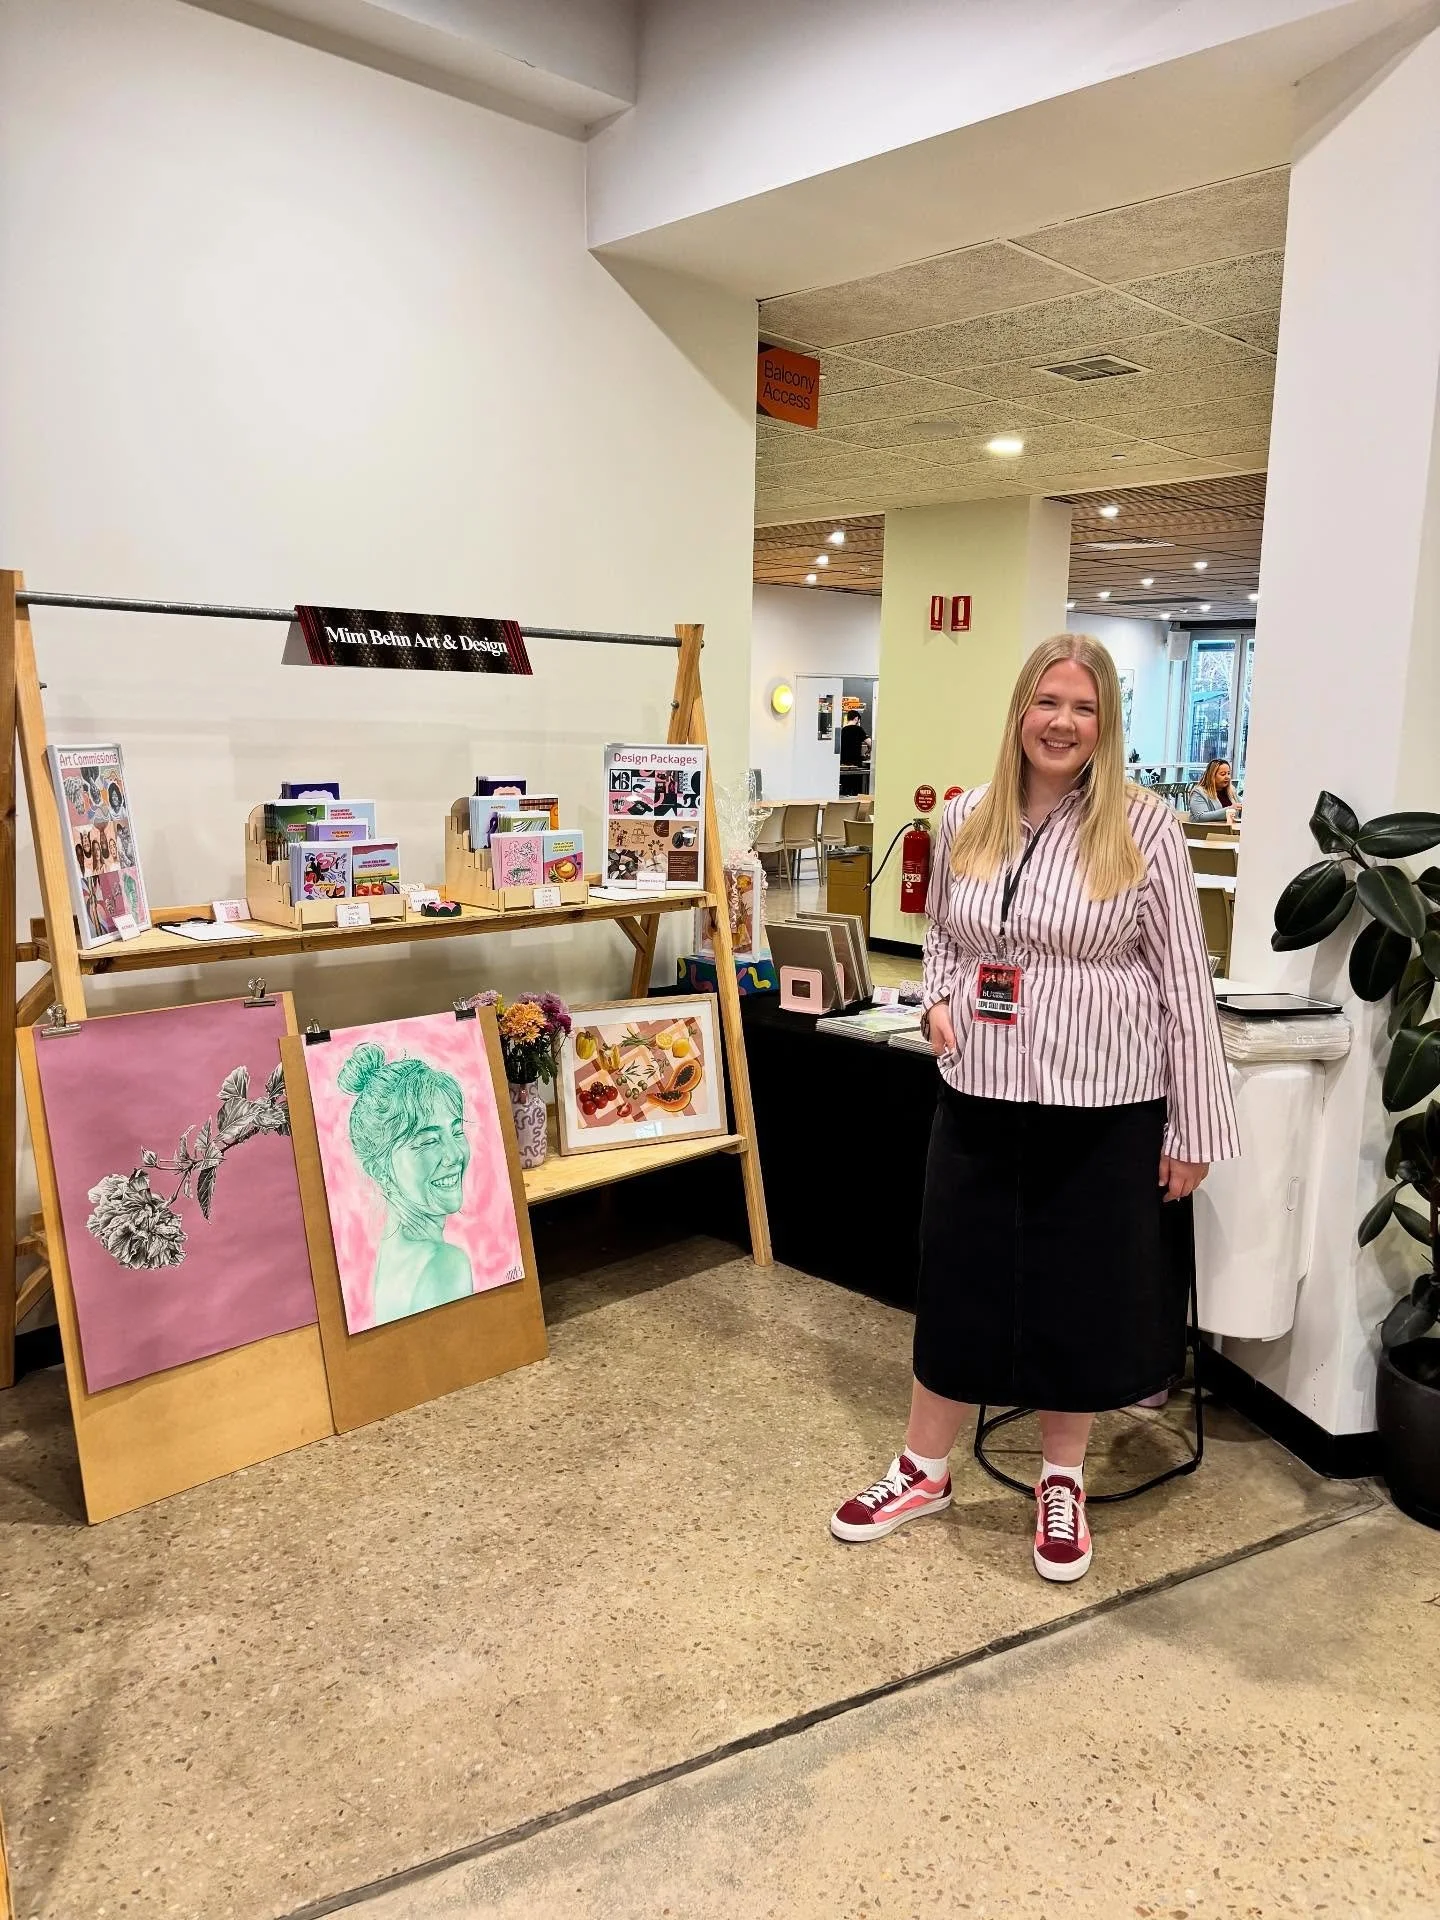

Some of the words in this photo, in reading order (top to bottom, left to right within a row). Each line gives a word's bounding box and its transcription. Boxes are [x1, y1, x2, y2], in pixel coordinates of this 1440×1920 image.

[764, 360, 815, 394] Balcony
[763, 382, 811, 410] Access
[324, 626, 367, 644] Mim
[368, 629, 411, 647] Behn
[414, 632, 440, 648] Art
[442, 634, 458, 650] &
[459, 635, 508, 656] Design
[59, 753, 72, 767] Art
[73, 752, 118, 766] Commissions
[613, 752, 648, 766] Design
[650, 753, 698, 766] Packages
